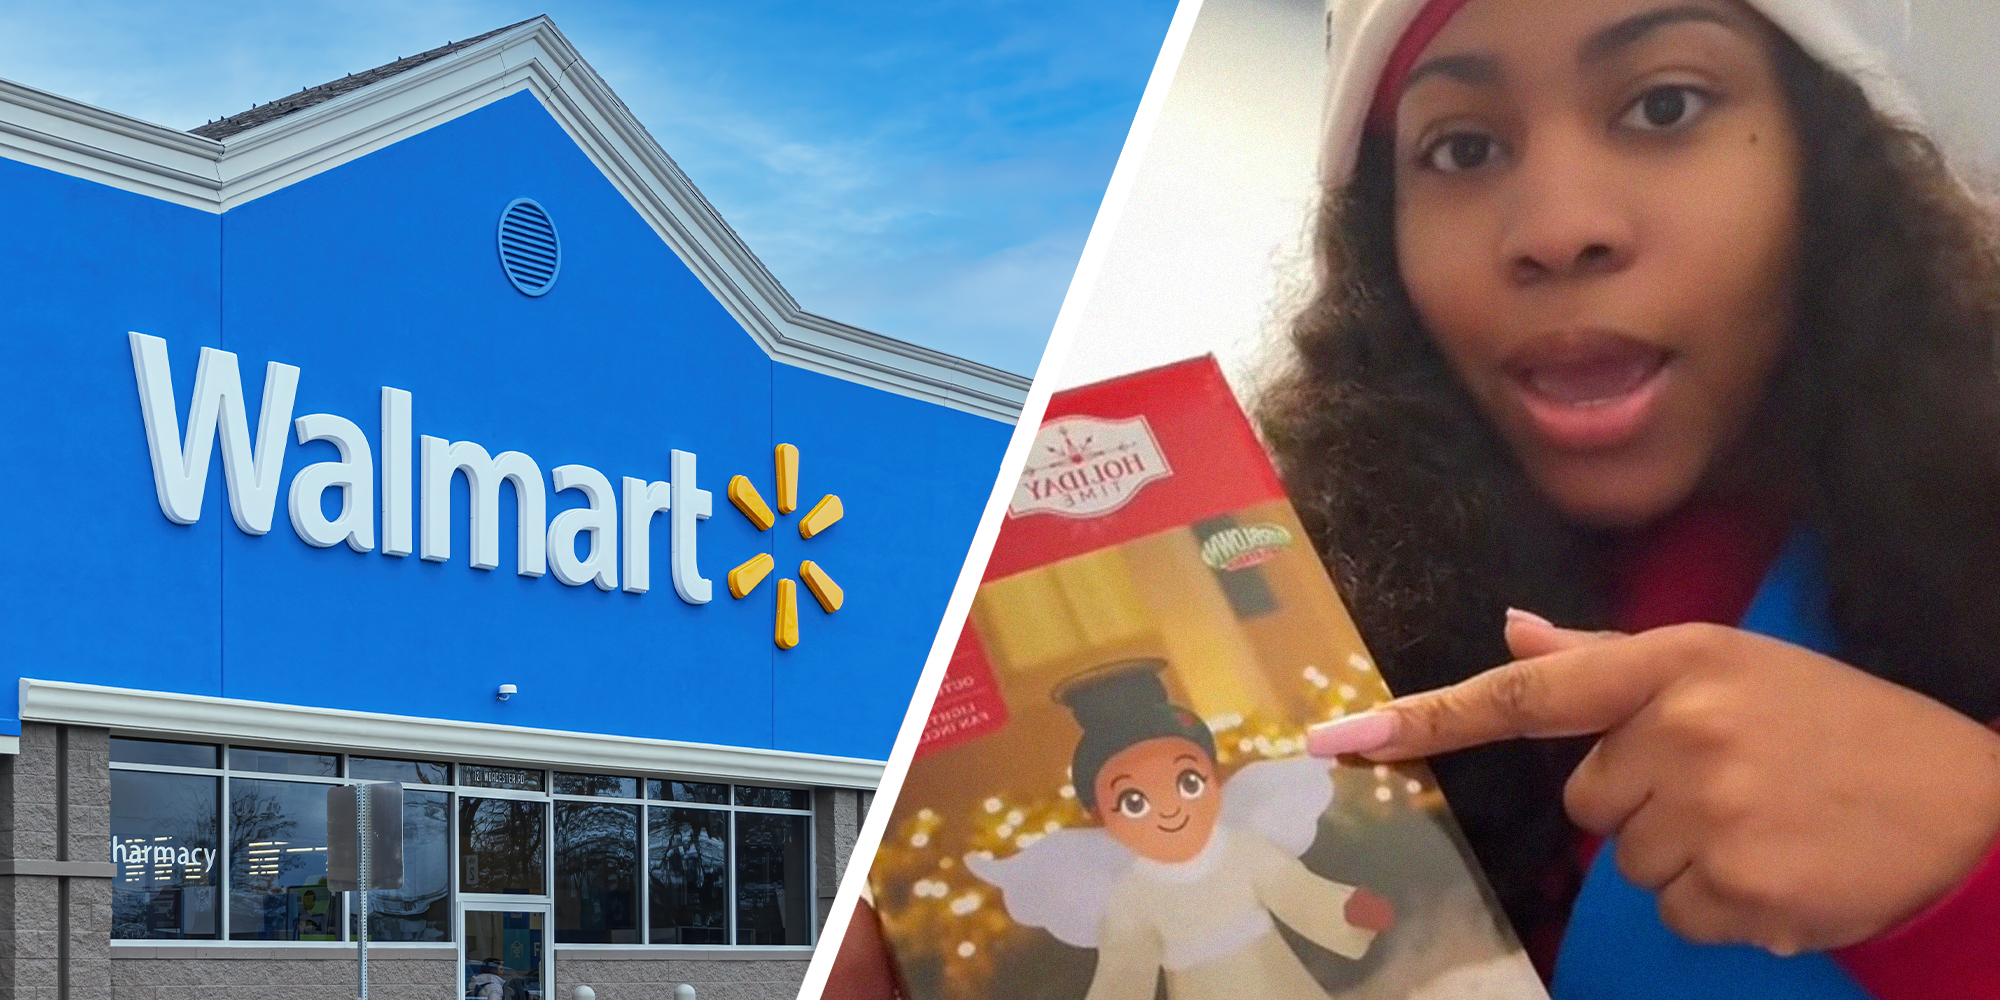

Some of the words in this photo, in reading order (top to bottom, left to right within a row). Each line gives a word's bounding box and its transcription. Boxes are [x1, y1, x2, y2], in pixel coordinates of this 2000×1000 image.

[128, 331, 713, 605] Walmart
[484, 772, 516, 784] WORCESTER
[110, 835, 217, 873] harmacy
